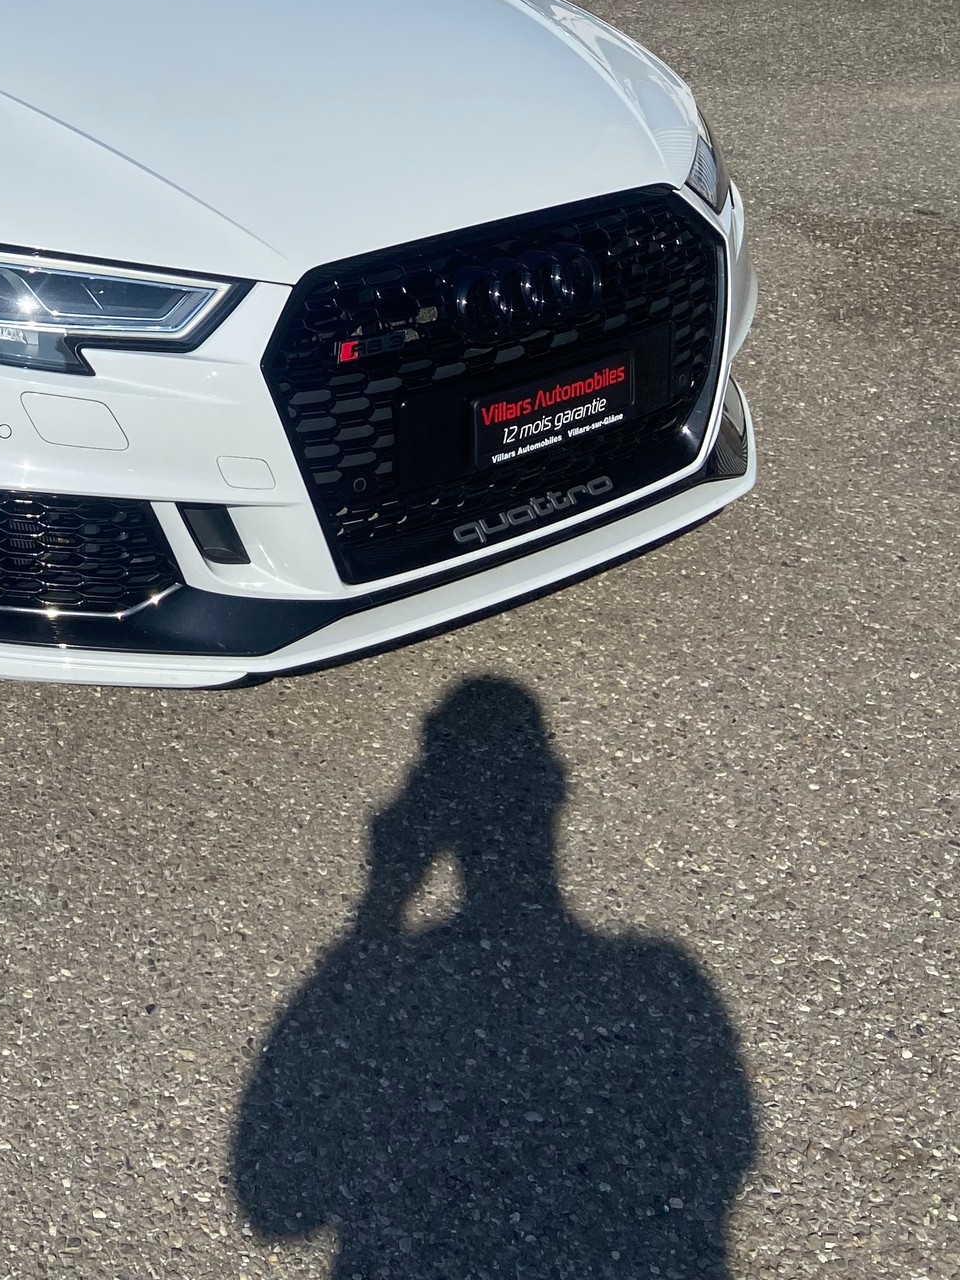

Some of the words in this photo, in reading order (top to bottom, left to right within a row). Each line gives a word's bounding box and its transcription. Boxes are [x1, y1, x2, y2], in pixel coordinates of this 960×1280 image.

[481, 398, 532, 426] Villars
[534, 366, 625, 411] Automobiles
[502, 425, 518, 444] 12
[519, 415, 552, 440] mois
[553, 396, 607, 430] garantie
[491, 449, 516, 464] Villars
[517, 434, 562, 456] Automobiles
[452, 475, 614, 544] quattro
